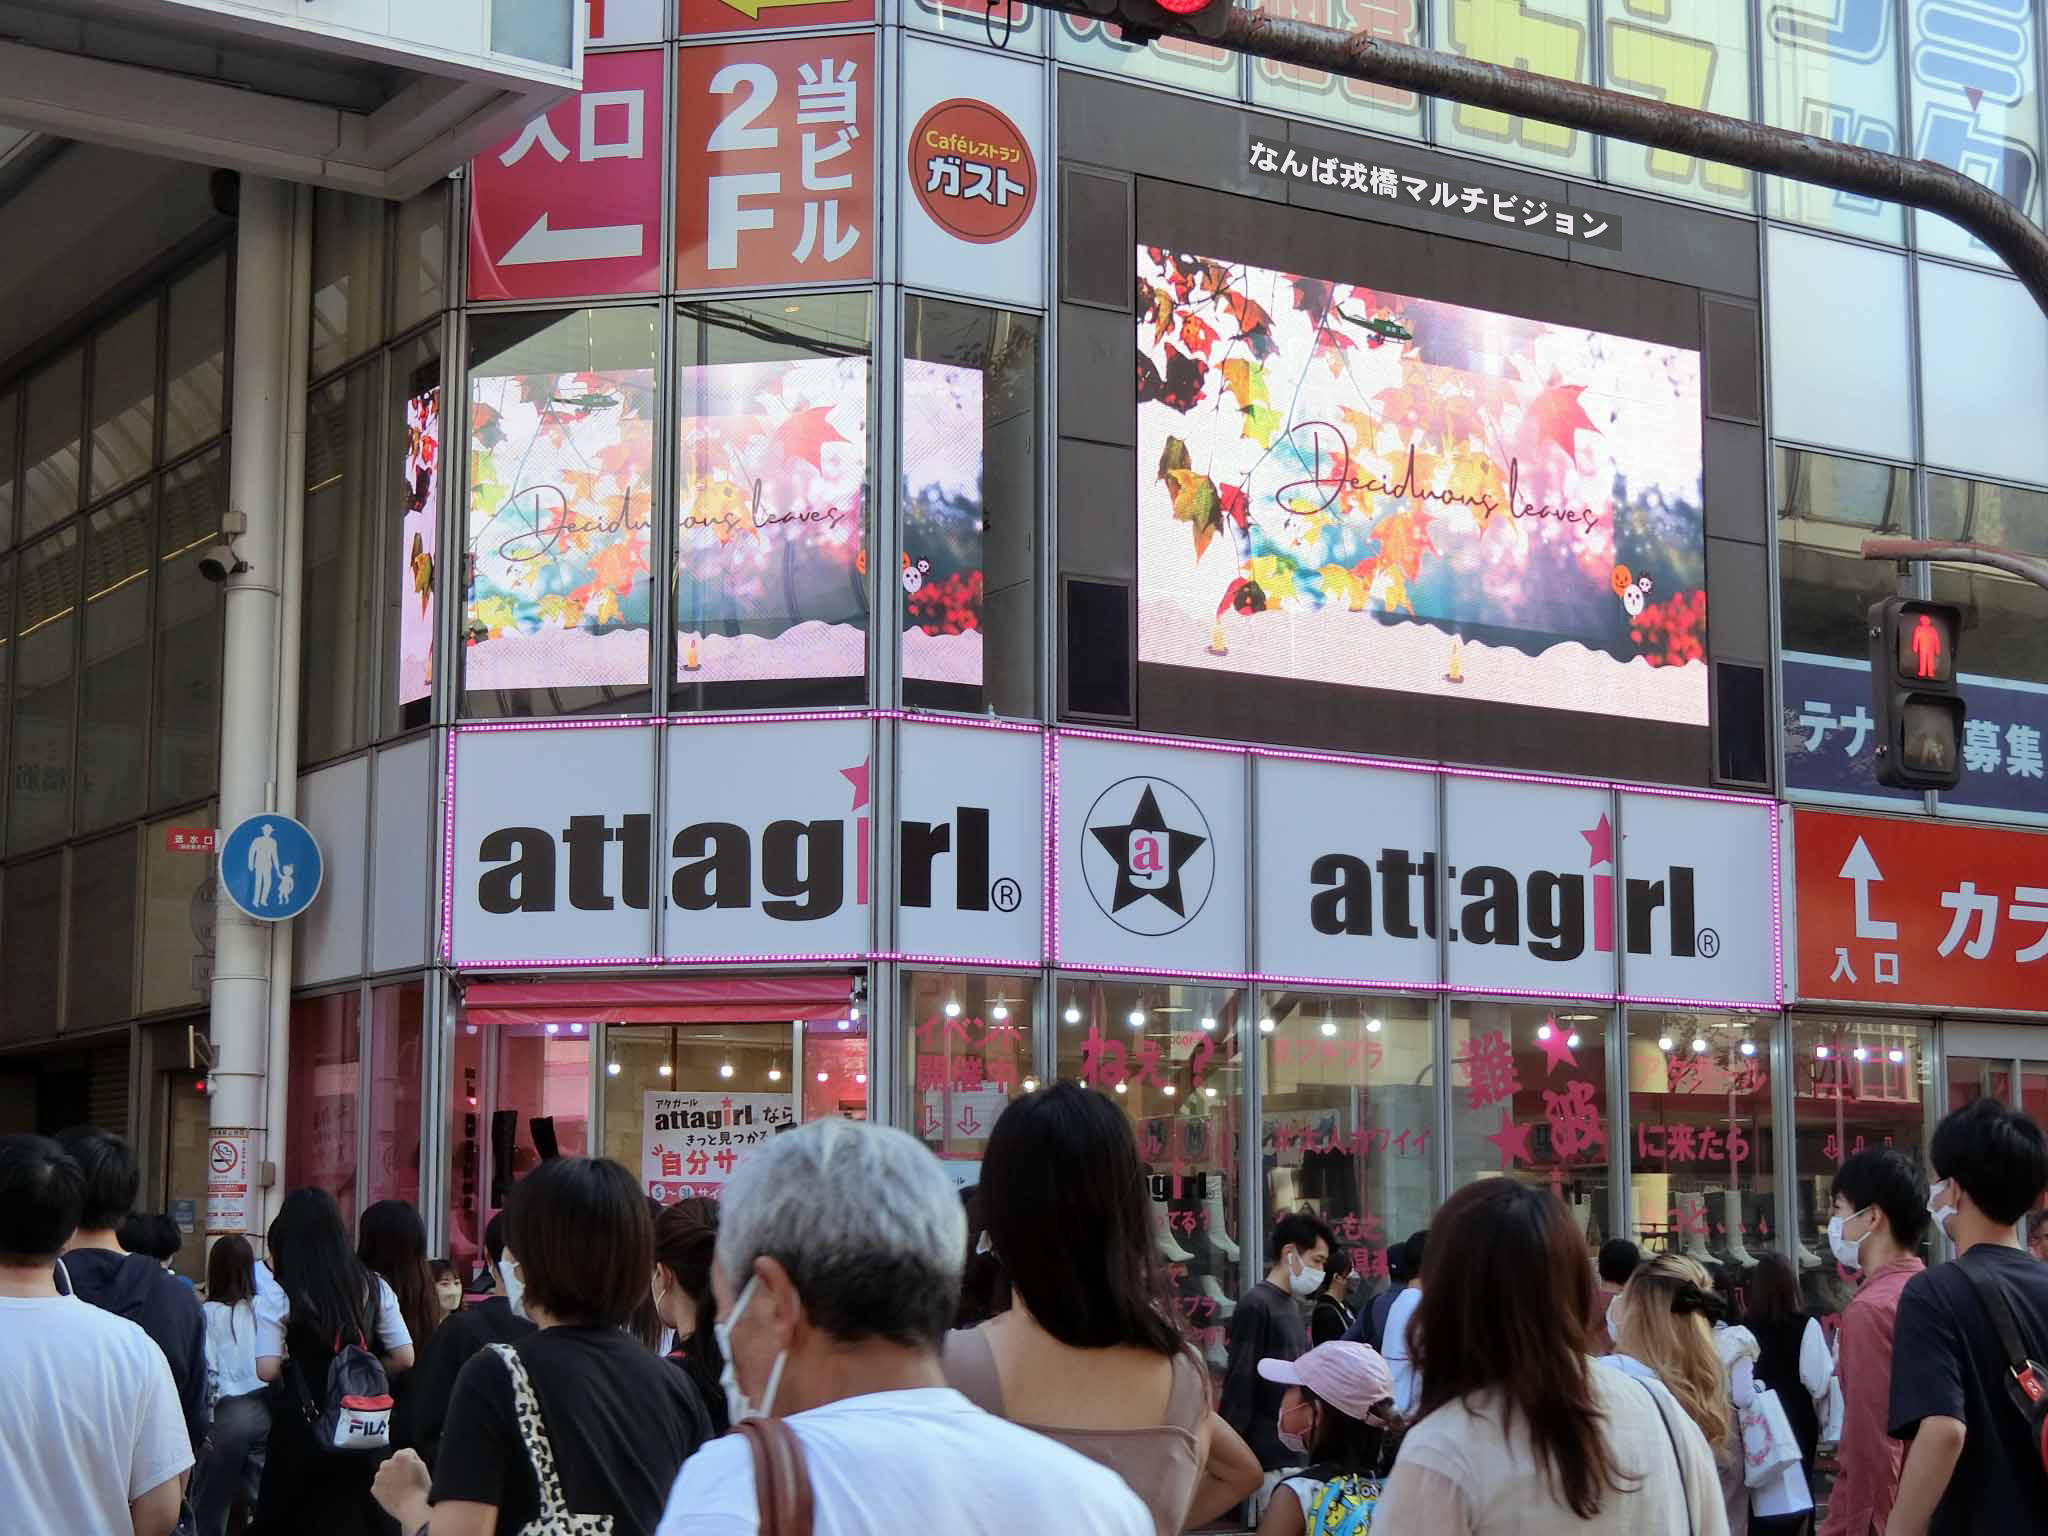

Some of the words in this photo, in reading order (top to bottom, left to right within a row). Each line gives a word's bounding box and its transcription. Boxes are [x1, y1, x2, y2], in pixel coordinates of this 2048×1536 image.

[499, 89, 644, 167] 入口
[706, 62, 781, 270] 2F
[791, 57, 860, 266] 当ビル
[927, 155, 1025, 207] ガスト
[1249, 141, 1609, 240] なんば戎橋マルチビジョン
[753, 478, 846, 530] leaves
[1276, 421, 1499, 515] Deciduous
[1510, 458, 1600, 535] leaves
[1830, 947, 1899, 984] 入口
[655, 1096, 752, 1130] attagirl
[1638, 1121, 1750, 1162] に来たら
[349, 1419, 387, 1436] FILA
